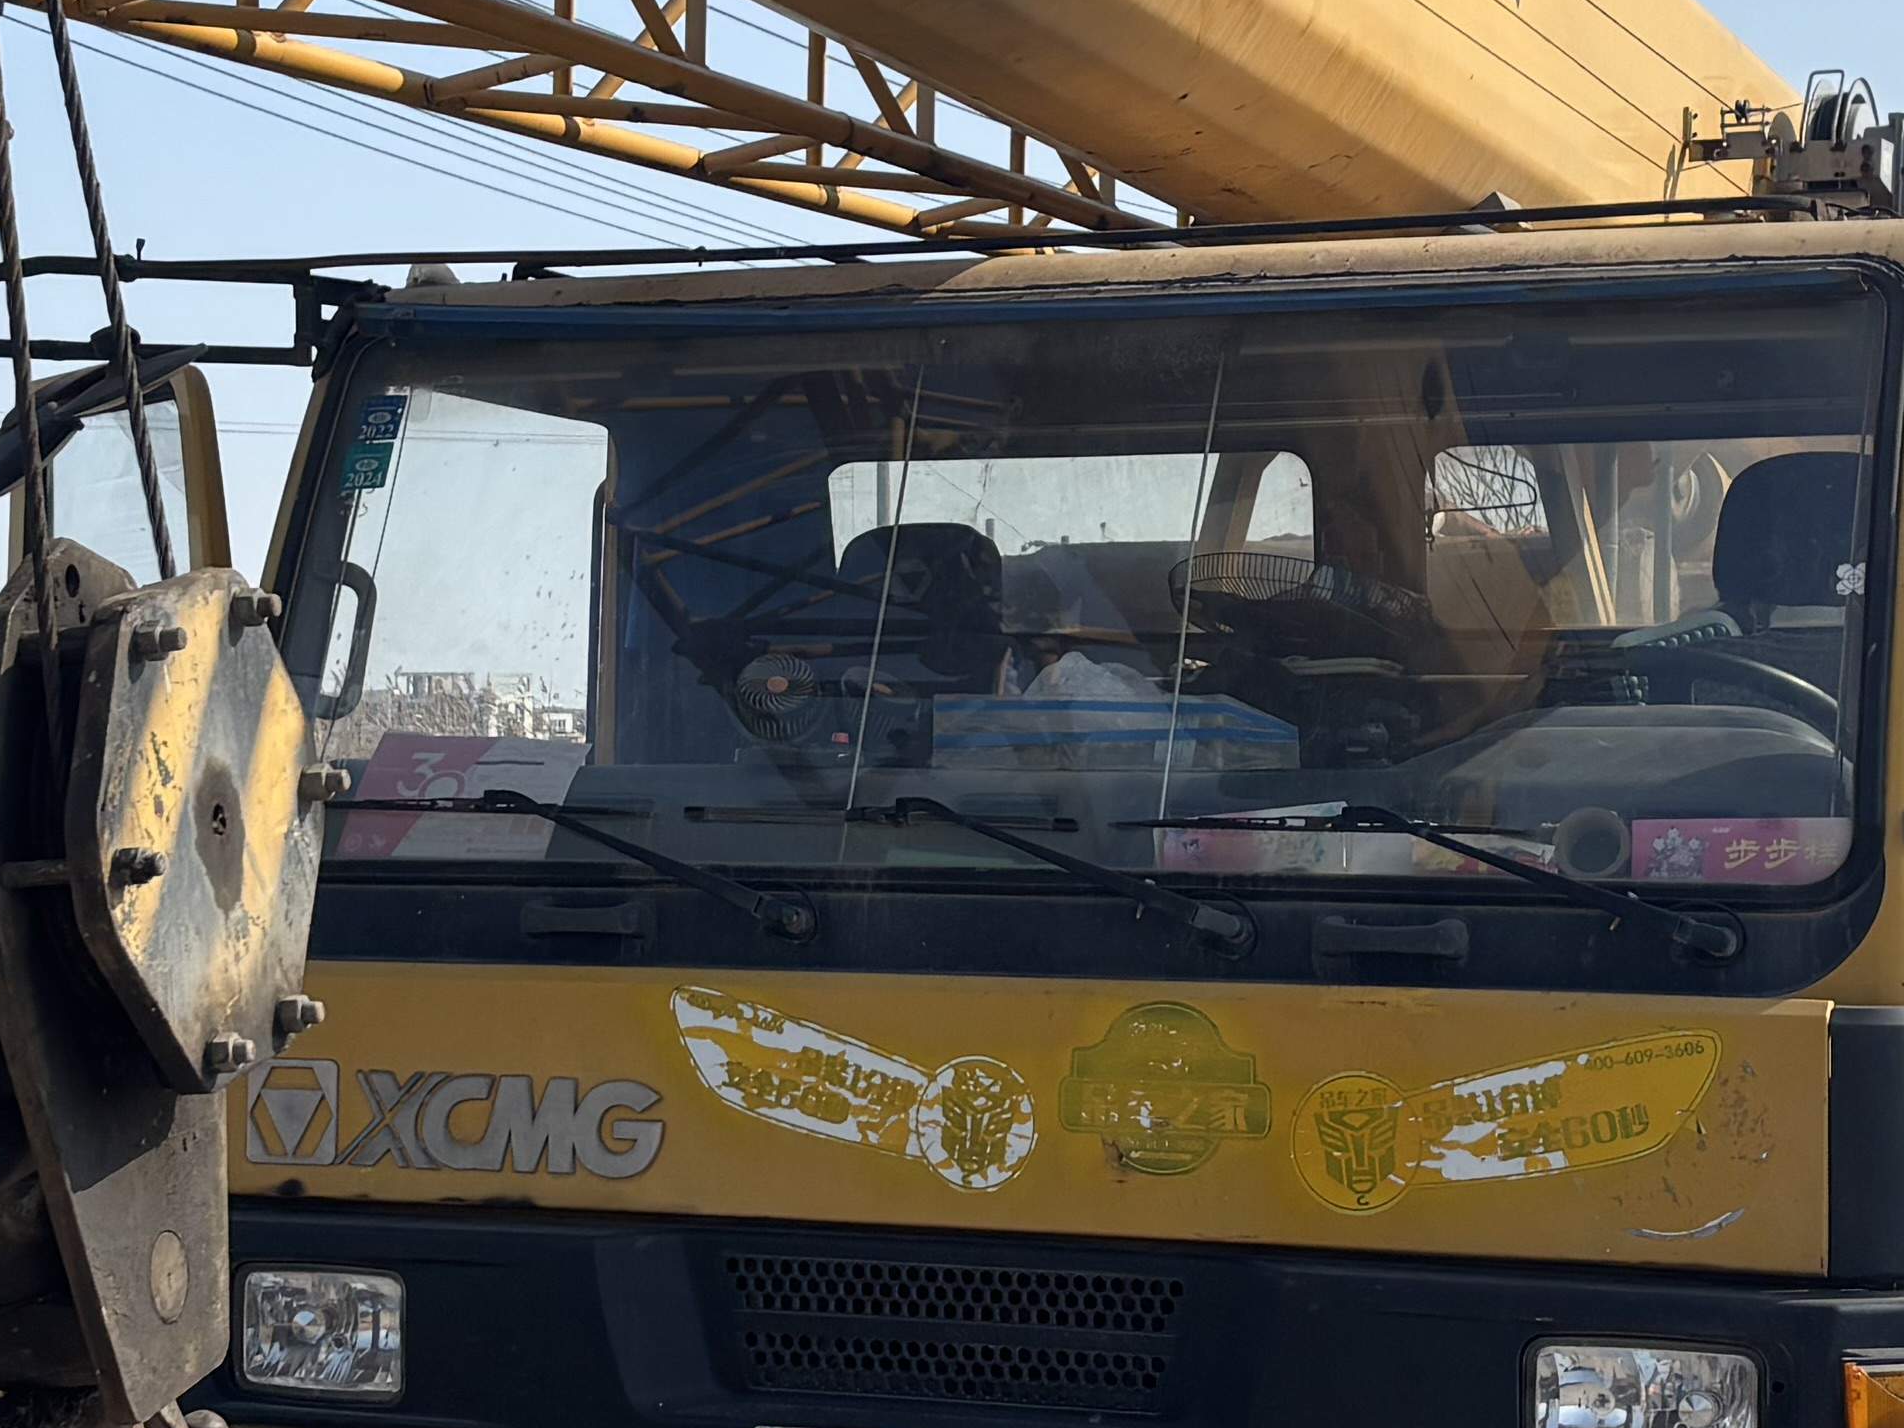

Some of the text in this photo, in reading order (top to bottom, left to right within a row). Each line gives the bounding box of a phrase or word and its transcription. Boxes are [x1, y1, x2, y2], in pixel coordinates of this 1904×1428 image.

[358, 425, 394, 440] 2022
[345, 472, 383, 487] 2024
[335, 1070, 664, 1178] XCMG
